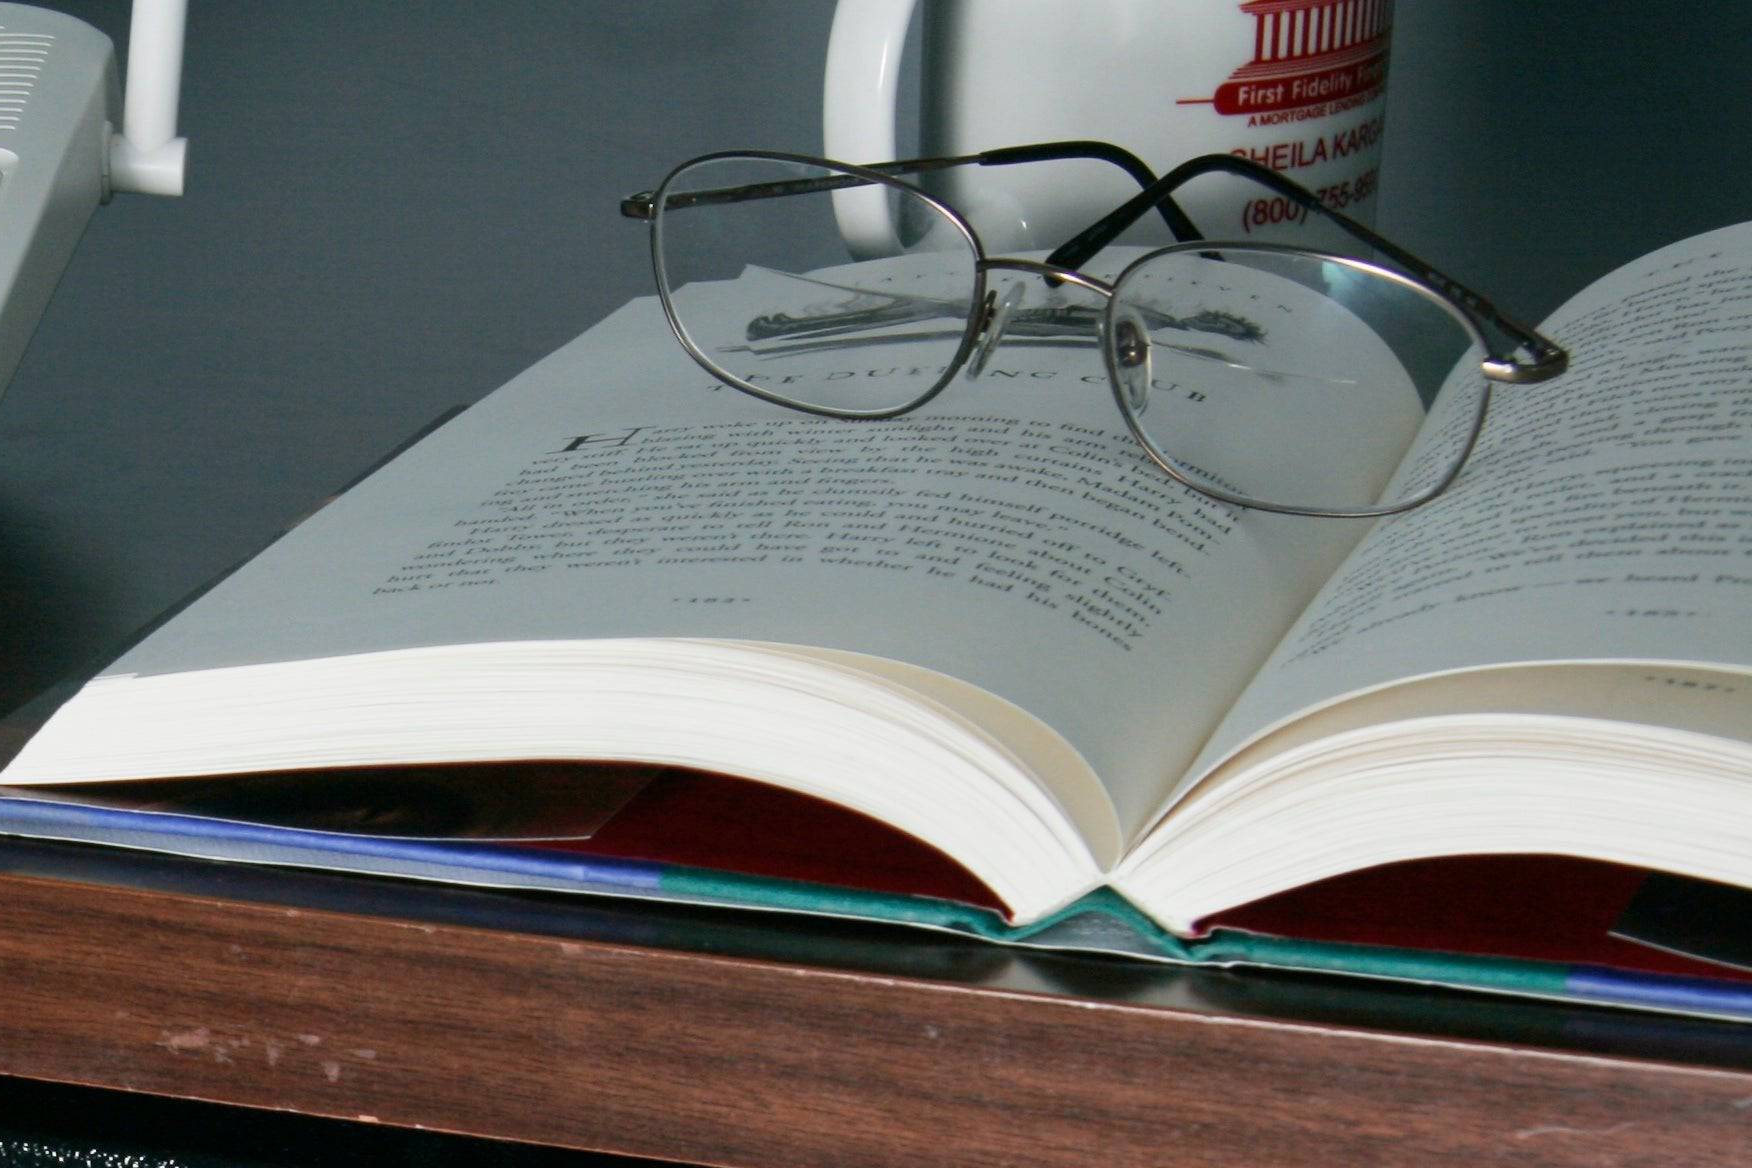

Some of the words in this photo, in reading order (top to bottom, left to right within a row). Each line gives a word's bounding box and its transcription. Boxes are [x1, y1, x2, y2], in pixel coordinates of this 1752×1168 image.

[1238, 84, 1285, 107] First
[1291, 70, 1353, 100] Fidelity
[915, 490, 952, 499] fed
[959, 493, 1048, 513] himself
[784, 519, 830, 529] Ron
[842, 521, 889, 531] and
[898, 523, 1017, 550] Hermione
[1027, 548, 1091, 575] about
[819, 509, 887, 519] could
[894, 513, 940, 522] and
[949, 516, 1034, 540] hurried
[1042, 538, 1082, 552] off
[1084, 552, 1107, 566] to
[657, 553, 768, 565] interested
[819, 556, 913, 572] whether
[969, 574, 1014, 592] had
[675, 542, 743, 552] could
[754, 543, 808, 552] have
[914, 553, 962, 565] and
[975, 562, 1051, 592] feeling
[905, 537, 943, 549] left
[987, 551, 1038, 571] look
[1049, 569, 1083, 587] for
[1624, 572, 1701, 584] heard
